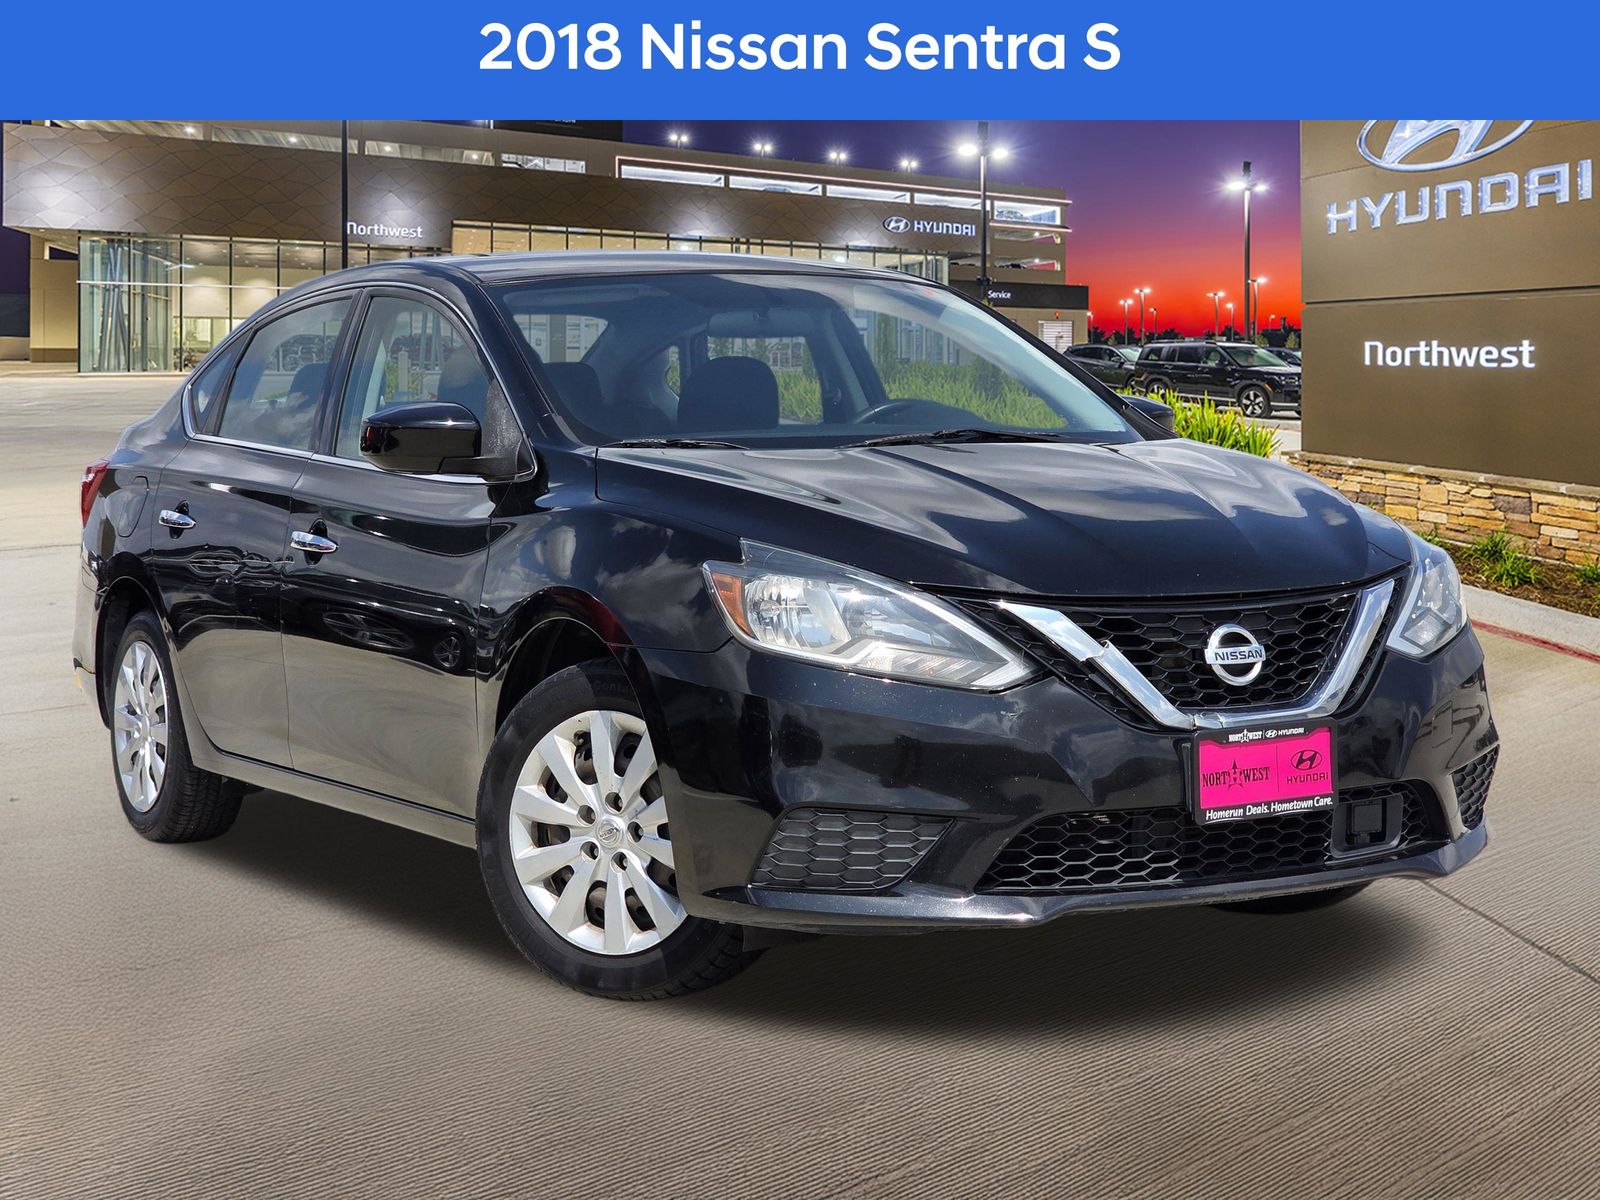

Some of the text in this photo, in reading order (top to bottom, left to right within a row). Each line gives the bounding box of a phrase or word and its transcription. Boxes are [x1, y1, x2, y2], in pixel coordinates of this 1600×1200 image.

[1326, 159, 1593, 235] HYUNDAI
[913, 220, 976, 236] HYUNDAI
[987, 289, 1012, 299] Service
[1214, 649, 1263, 661] NISSAN
[1286, 771, 1329, 785] HYUNDAI
[1206, 795, 1333, 820] Homerun Deals. Hometown Care.
